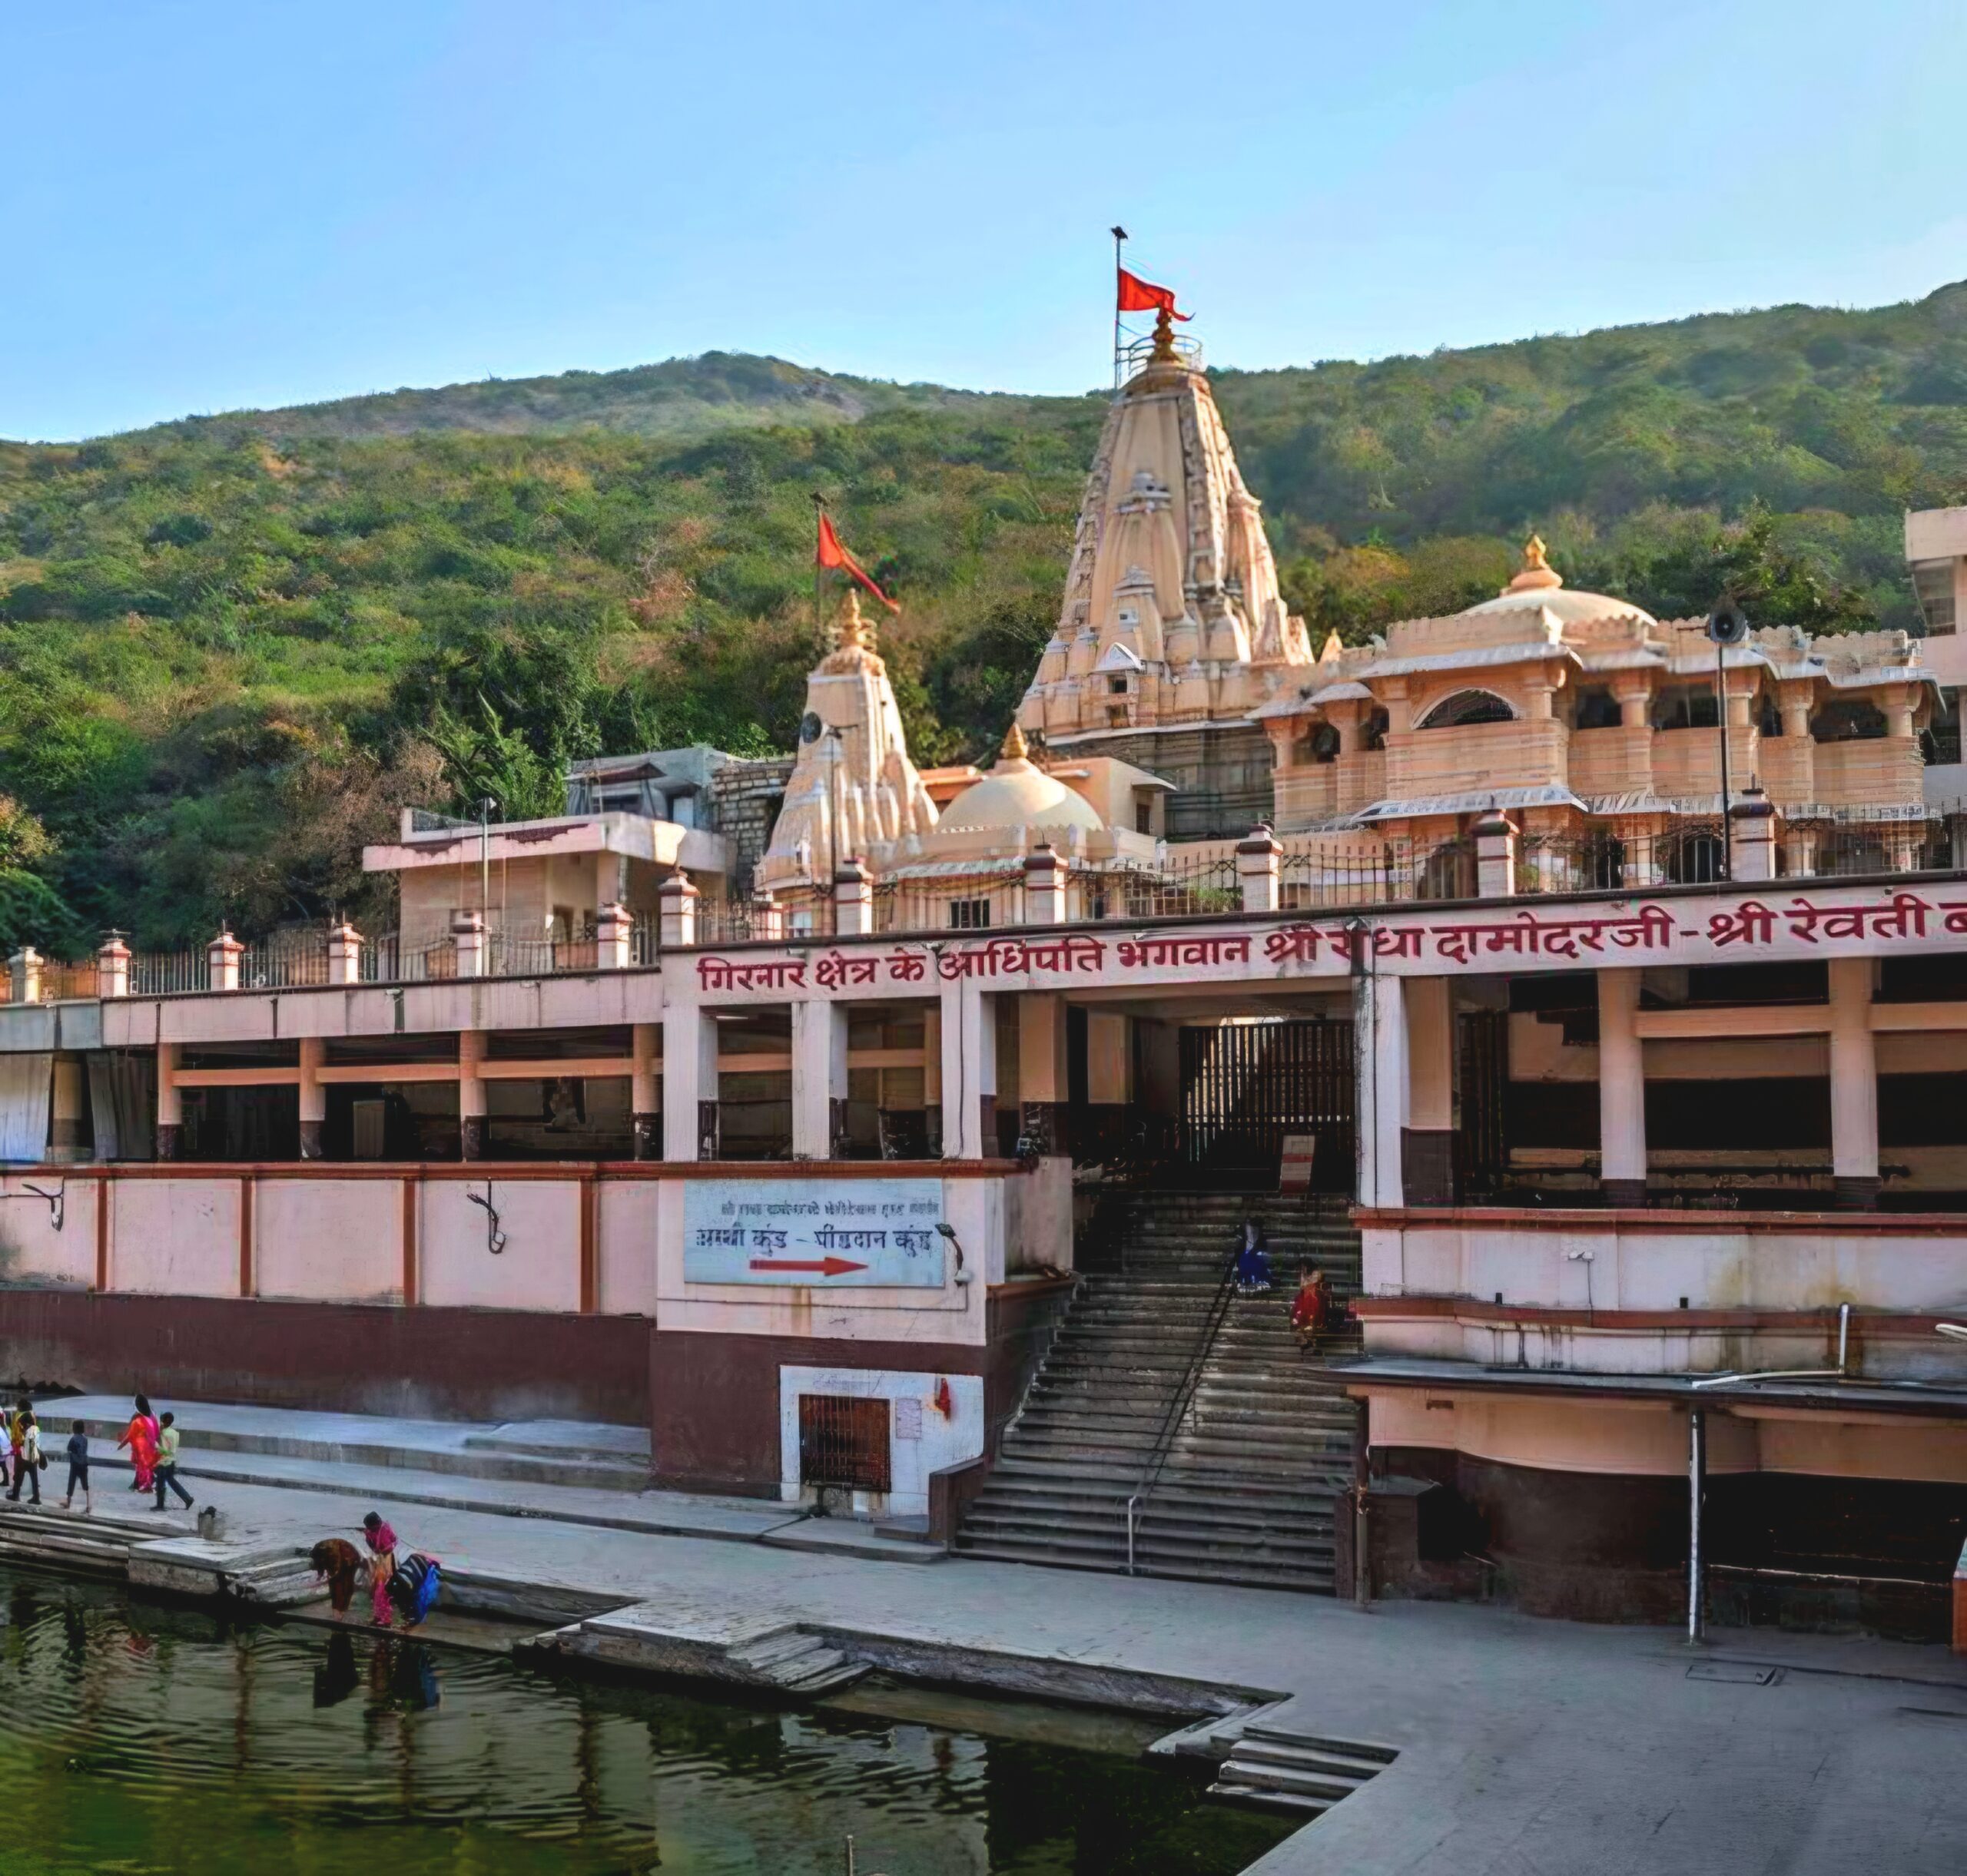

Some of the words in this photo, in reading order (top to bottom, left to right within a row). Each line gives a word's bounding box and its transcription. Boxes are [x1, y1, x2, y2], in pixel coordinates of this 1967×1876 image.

[697, 956, 808, 991] गिरनार
[815, 950, 880, 991] क्षेत्र
[885, 946, 927, 981] के
[1116, 936, 1252, 968] भगवान
[1706, 901, 1779, 947] श्री
[1783, 897, 1933, 943] रेवती
